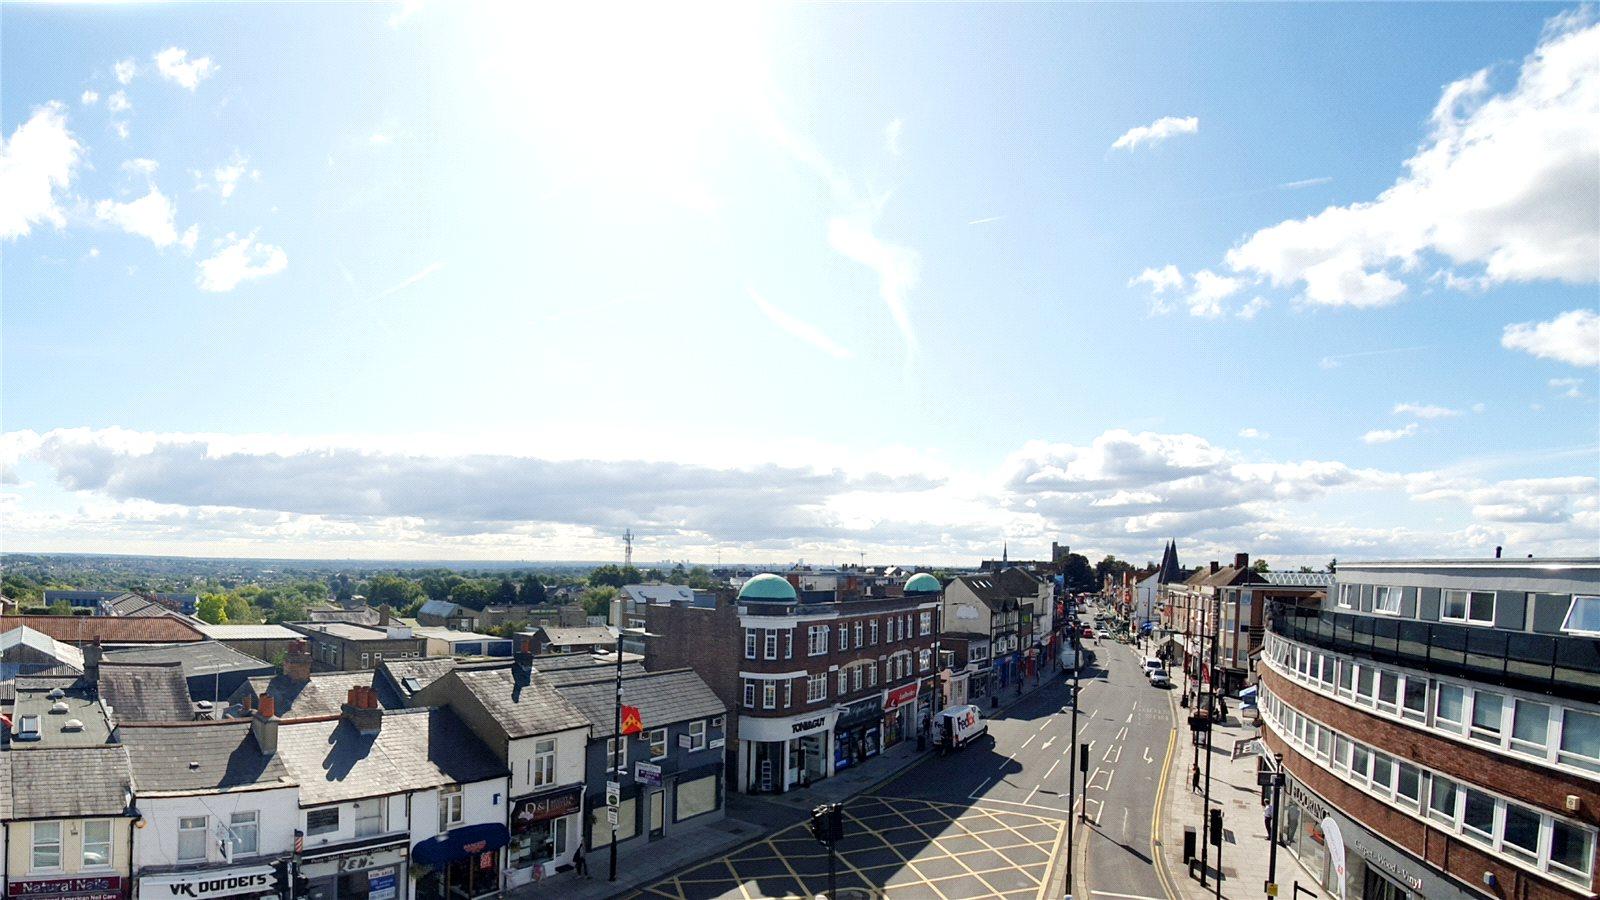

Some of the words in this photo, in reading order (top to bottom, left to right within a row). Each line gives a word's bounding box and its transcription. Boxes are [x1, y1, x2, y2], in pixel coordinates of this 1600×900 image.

[957, 711, 976, 732] FedEx
[22, 880, 73, 894] Natural
[76, 878, 110, 891] Nails
[1402, 868, 1423, 890] Vinyl
